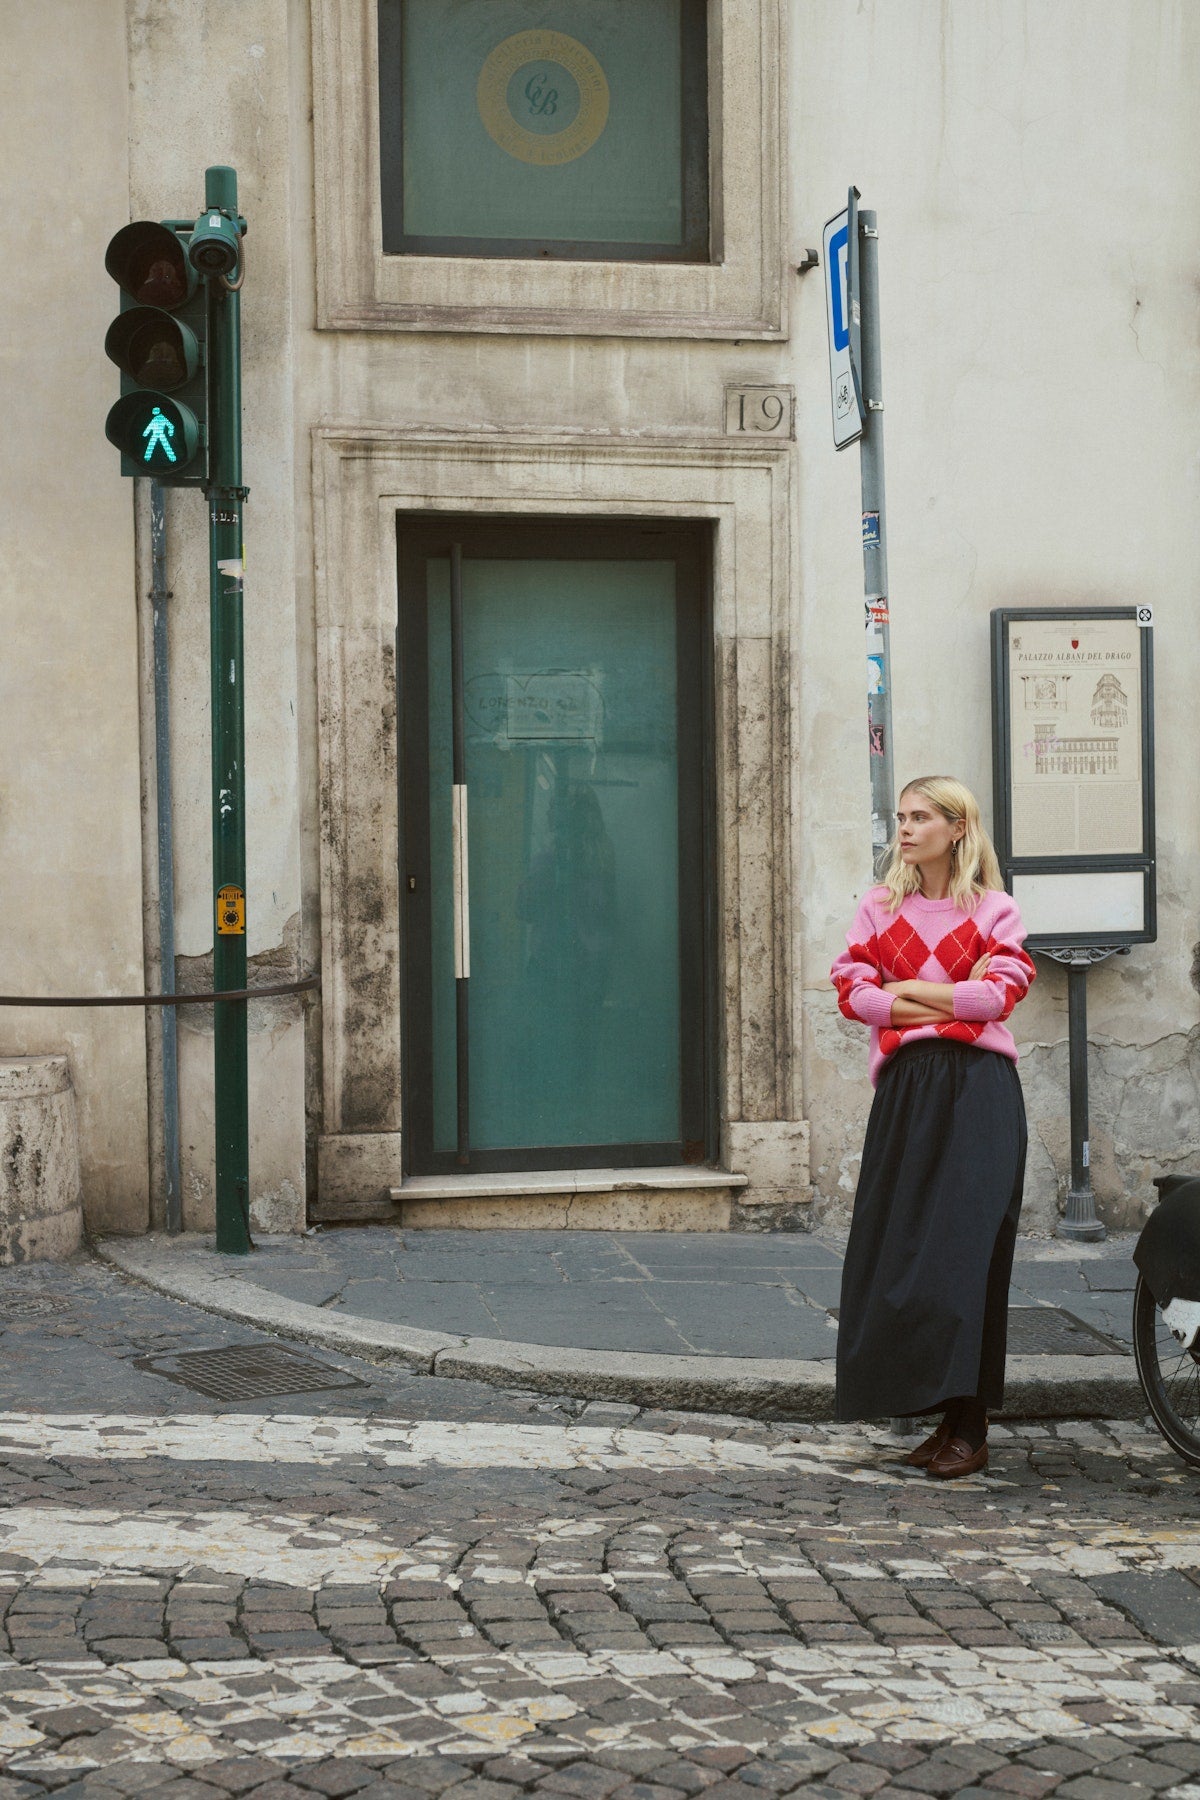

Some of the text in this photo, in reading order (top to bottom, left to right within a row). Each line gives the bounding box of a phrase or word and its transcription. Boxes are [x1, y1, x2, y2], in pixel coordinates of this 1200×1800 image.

[736, 394, 784, 432] 19
[1018, 652, 1132, 661] PALAZZO ALBANI DEL DRAGO
[478, 695, 549, 710] LORENZO
